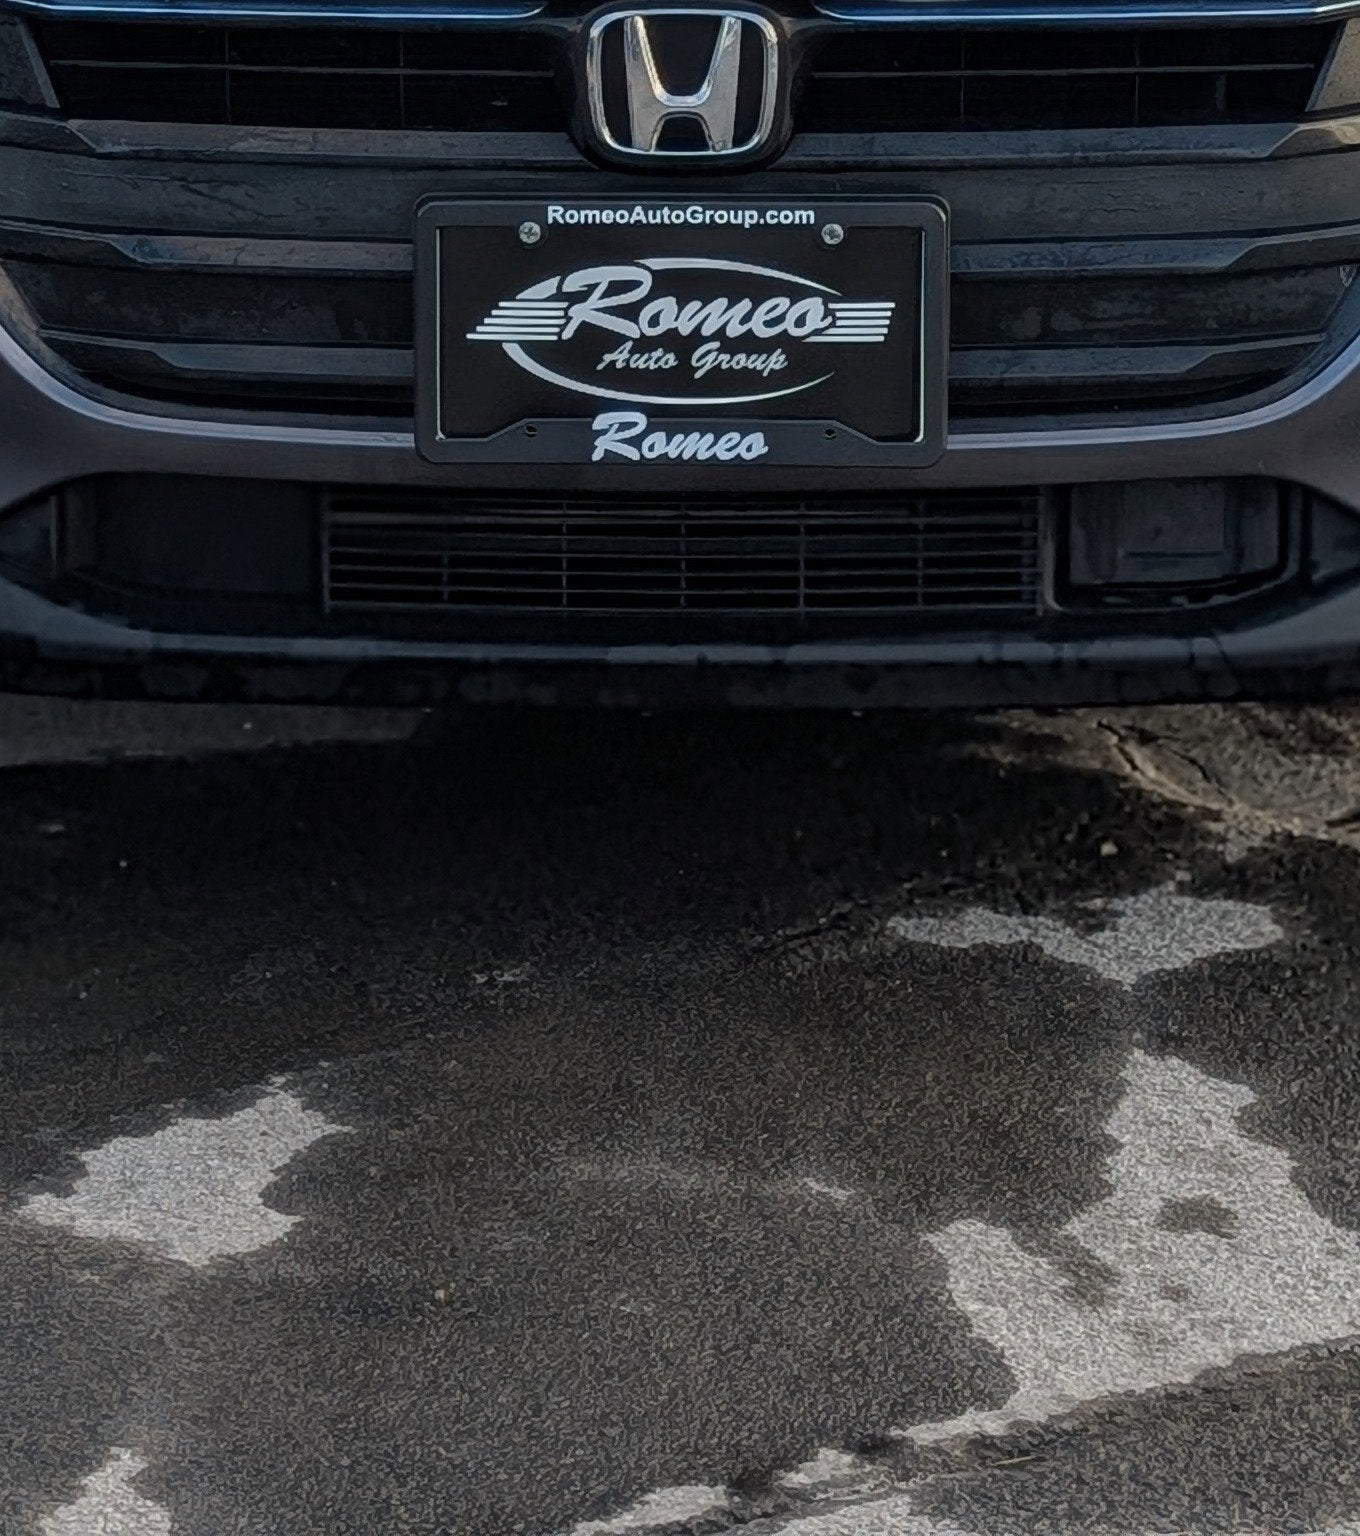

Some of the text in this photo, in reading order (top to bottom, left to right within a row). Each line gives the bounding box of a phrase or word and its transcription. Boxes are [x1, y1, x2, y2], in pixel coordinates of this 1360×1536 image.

[547, 205, 815, 227] RomeoAutoGroup.com
[562, 265, 832, 340] Romeo
[596, 340, 788, 379] Auto Group
[592, 411, 768, 461] Romeo
